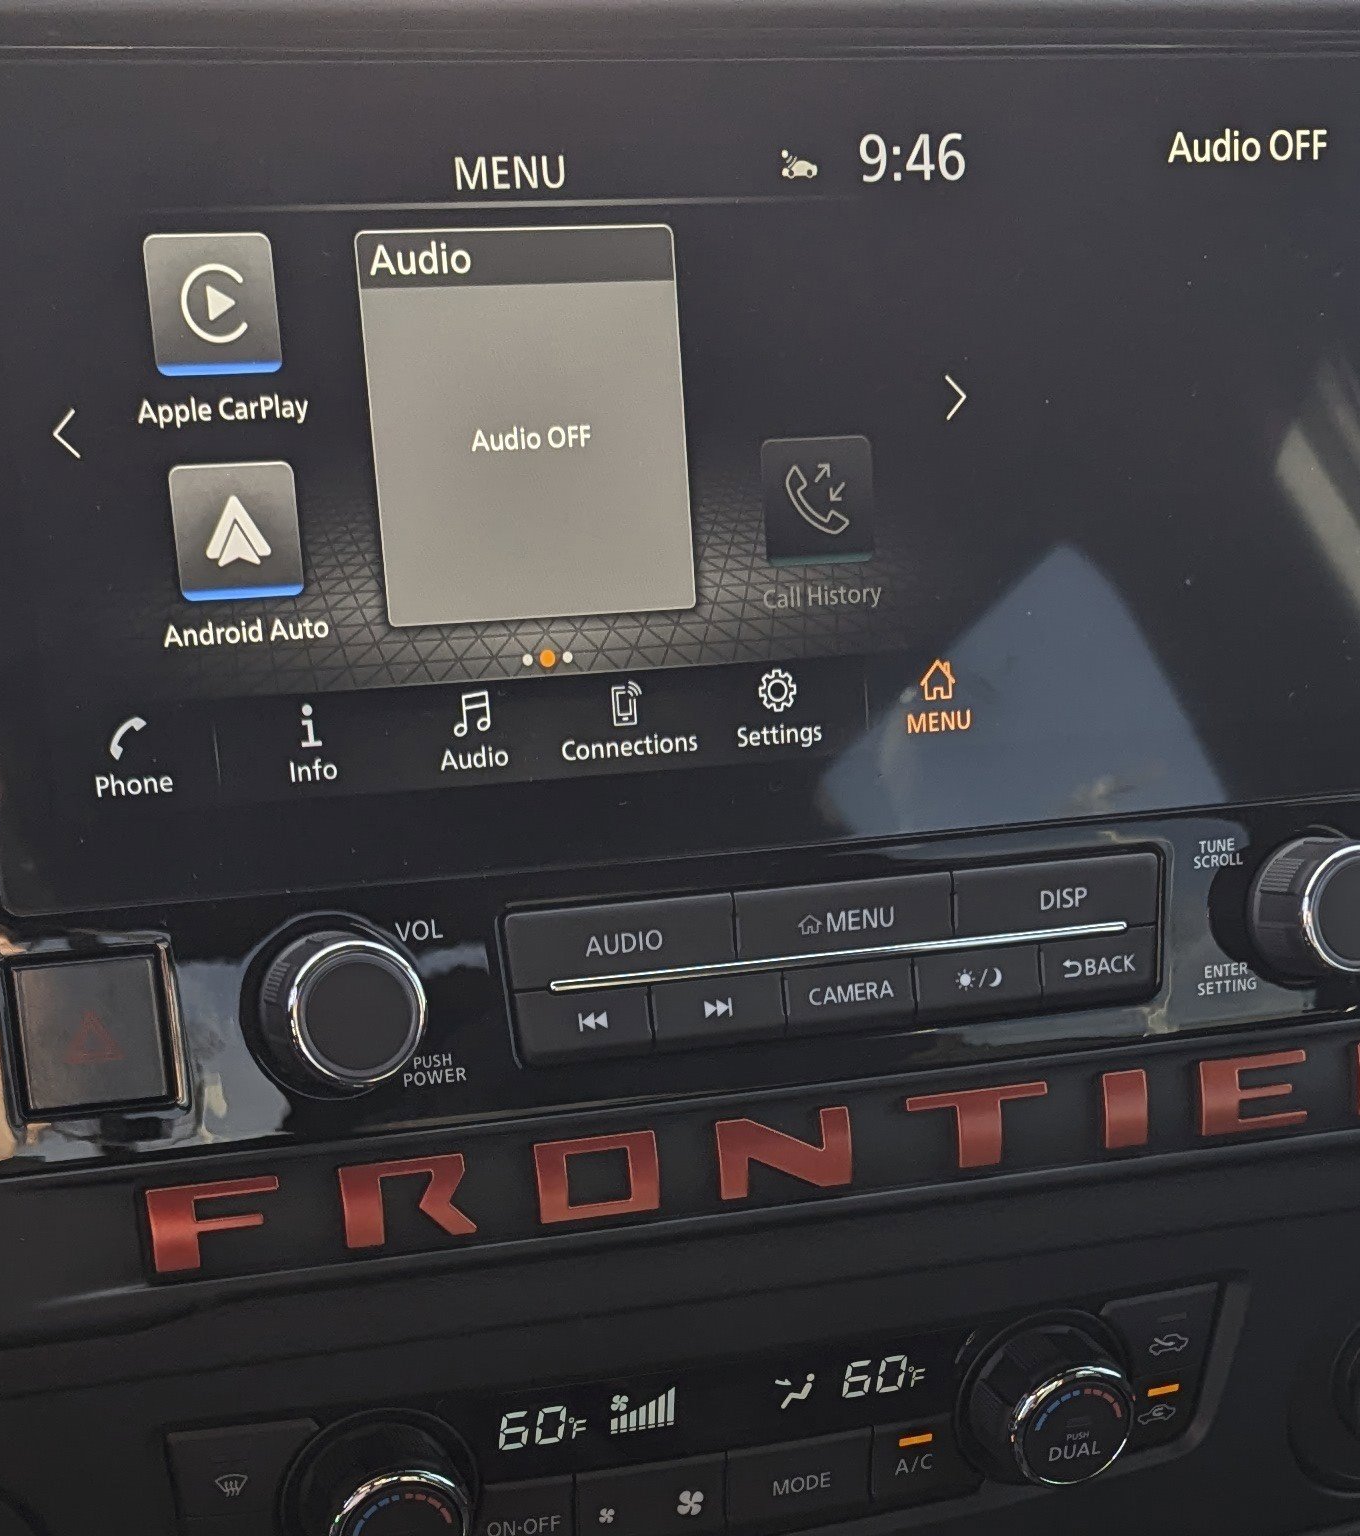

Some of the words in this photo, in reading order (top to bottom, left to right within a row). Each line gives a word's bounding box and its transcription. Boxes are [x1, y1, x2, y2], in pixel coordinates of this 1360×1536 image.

[858, 132, 967, 183] 9:46
[1168, 129, 1260, 164] Audio
[1268, 128, 1328, 161] OFF
[454, 155, 566, 191] MENU
[369, 241, 472, 276] Audio
[137, 397, 211, 428] Apple
[218, 395, 309, 424] CarPlay
[471, 427, 541, 452] Audio
[548, 425, 591, 449] OFF
[763, 587, 801, 611] Call
[808, 583, 882, 610] History
[163, 620, 263, 649] Android
[270, 619, 329, 642] Auto
[907, 710, 972, 734] MENU
[561, 732, 698, 762] Connections
[737, 722, 822, 749] Settings
[441, 746, 509, 771] Audio
[289, 761, 338, 784] Info
[95, 774, 174, 798] Phone
[1199, 837, 1236, 854] TUNE
[1193, 850, 1244, 870] SCROLL
[1040, 886, 1088, 911] DISP
[395, 920, 443, 942] VOL
[826, 907, 895, 933] MENU
[585, 929, 663, 958] AUDIO
[1085, 953, 1136, 978] BACK
[1204, 961, 1249, 980] ENTER
[809, 980, 894, 1006] CAMERA
[1197, 977, 1257, 997] SETTING
[412, 1052, 453, 1071] PUSH
[402, 1066, 468, 1089] POWER
[1066, 1431, 1091, 1443] PUSH
[1047, 1441, 1103, 1463] DUAL
[894, 1453, 934, 1477] A/C
[772, 1471, 832, 1497] MODE
